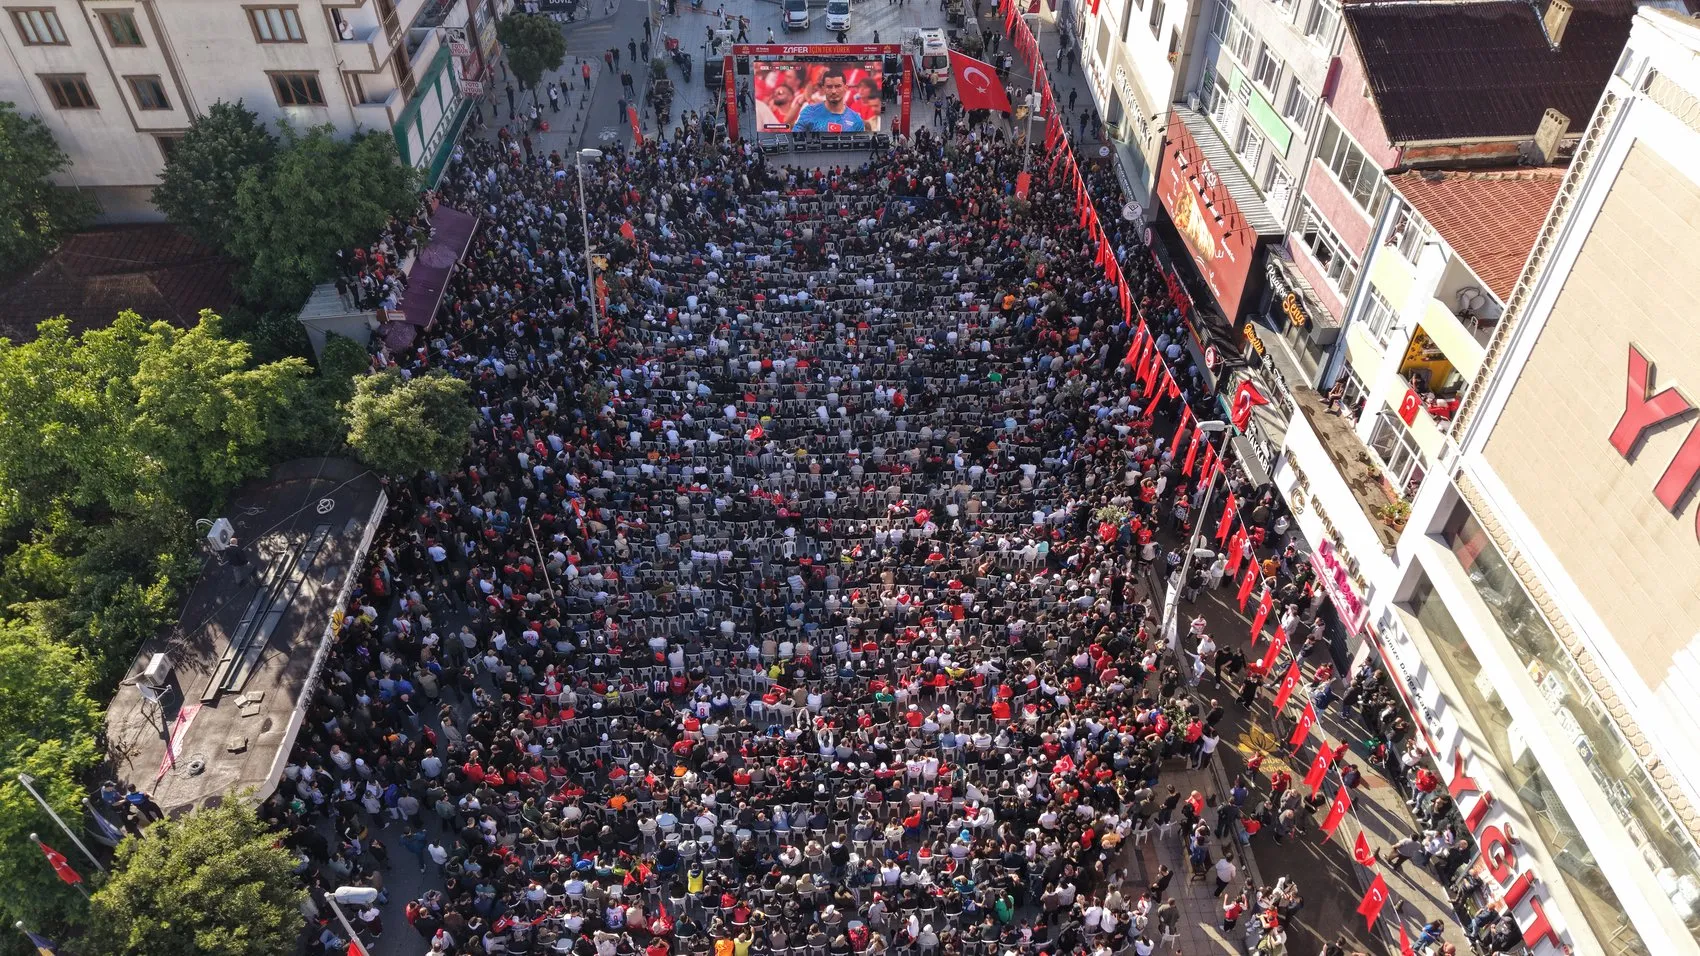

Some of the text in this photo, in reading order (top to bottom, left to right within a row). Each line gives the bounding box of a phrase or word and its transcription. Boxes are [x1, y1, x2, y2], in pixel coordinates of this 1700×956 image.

[783, 46, 808, 54] ZAFER
[823, 46, 833, 54] TEK
[1283, 293, 1305, 326] Sena
[1310, 494, 1370, 596] KUYUMCULUK
[1449, 745, 1561, 949] YİĞİT
